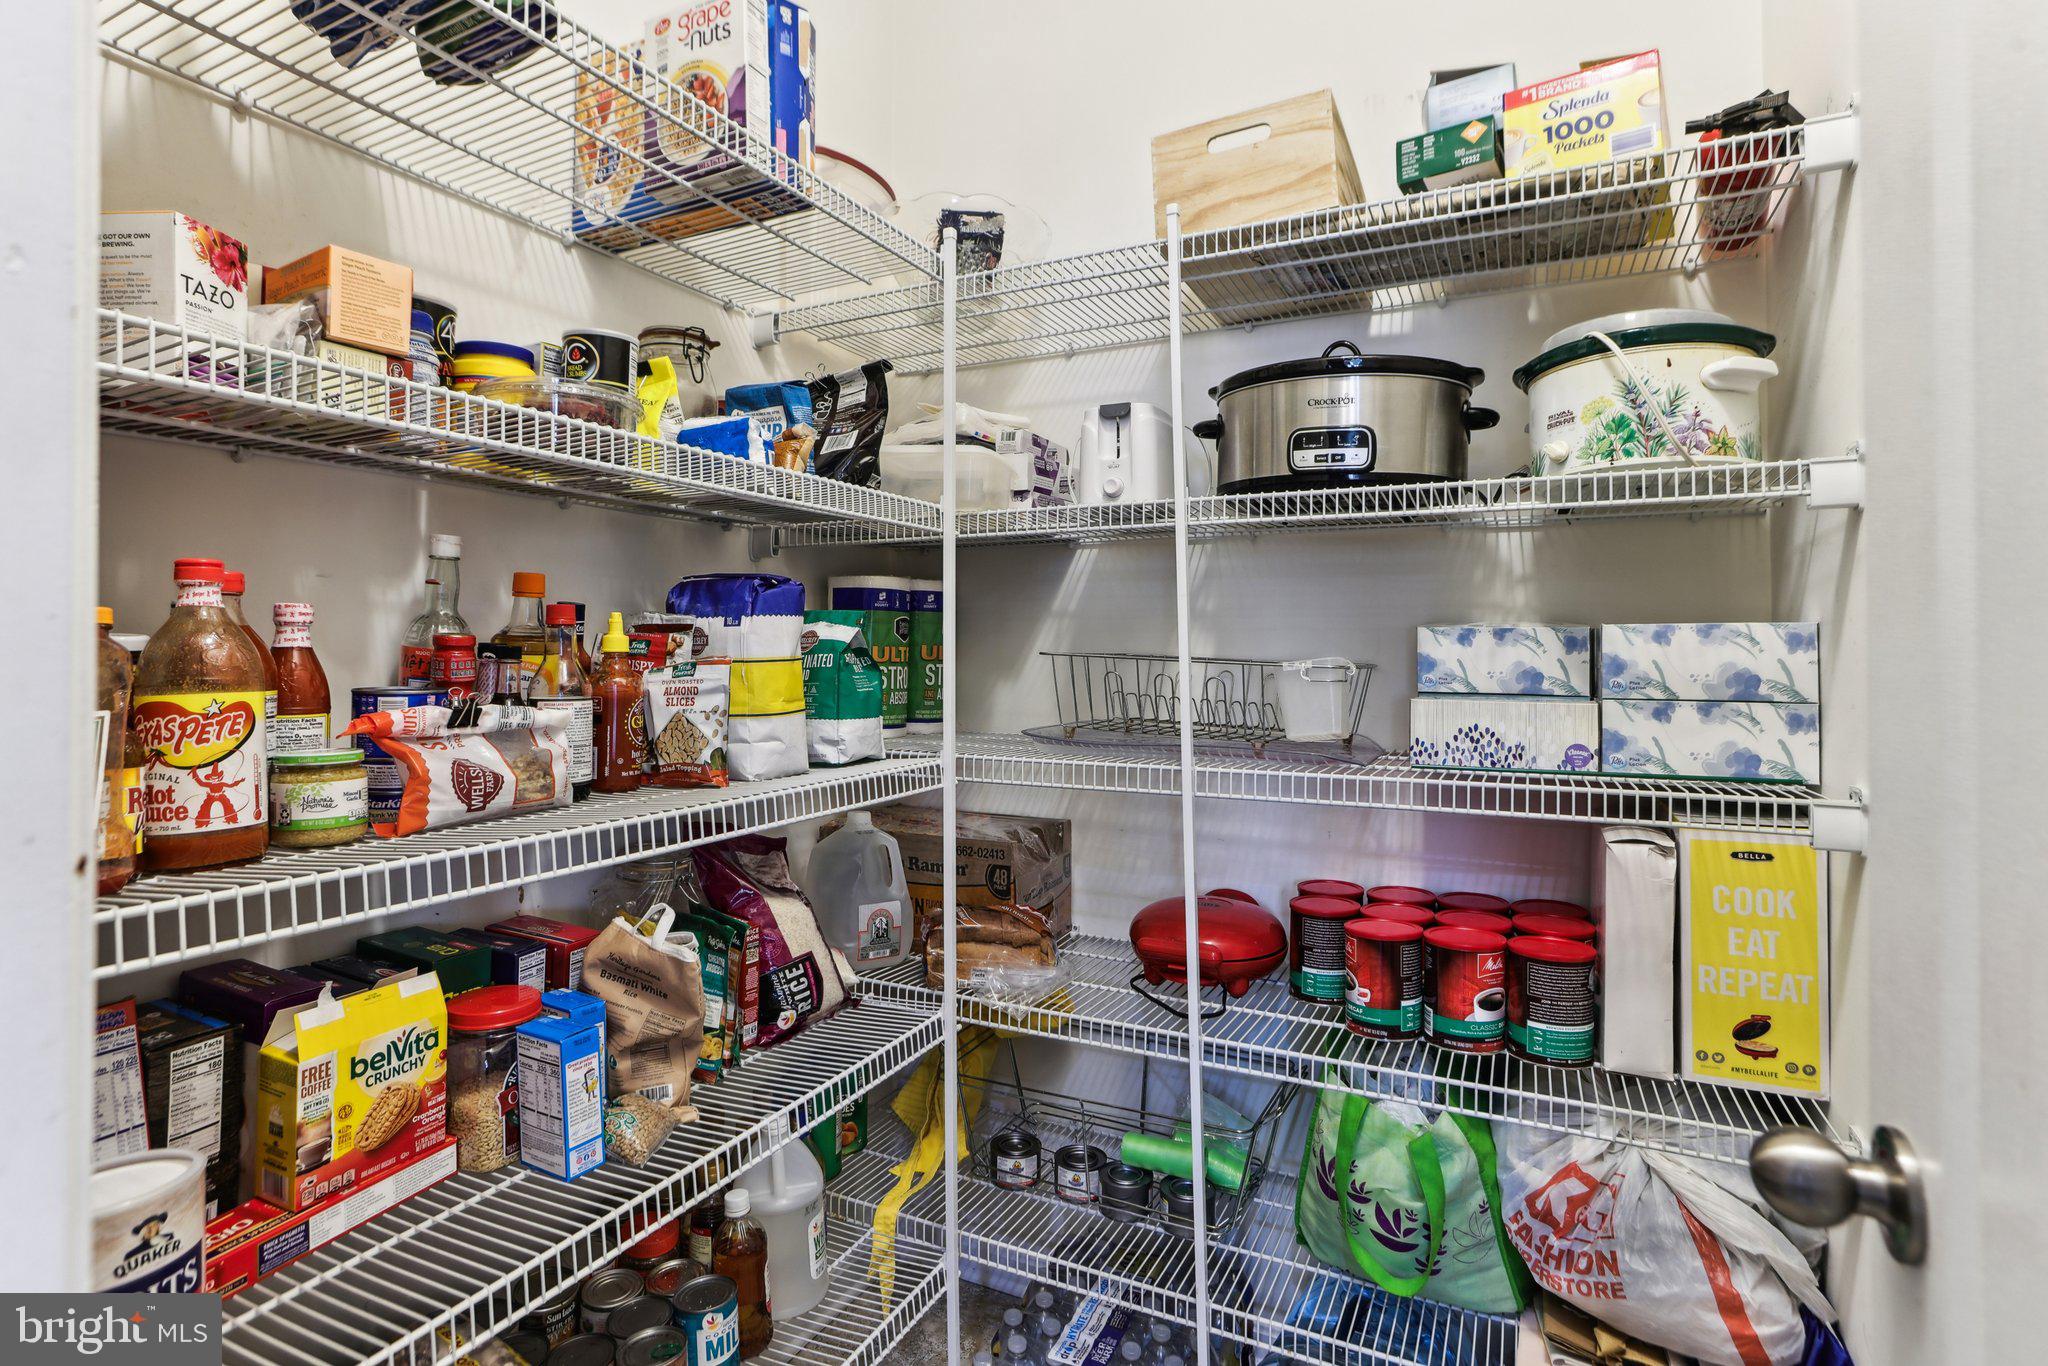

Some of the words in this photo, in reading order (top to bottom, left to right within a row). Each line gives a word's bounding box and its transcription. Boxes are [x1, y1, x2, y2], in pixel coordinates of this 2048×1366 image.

[678, 0, 731, 41] grape
[1521, 86, 1537, 102] #1
[1543, 90, 1610, 120] Splenda
[1543, 110, 1615, 143] 1000
[1554, 132, 1605, 155] Packets
[181, 273, 235, 310] TAZO
[185, 300, 213, 314] PASSION
[872, 645, 909, 663] ULT
[628, 660, 654, 672] ISPY
[663, 686, 699, 696] ALMOND
[665, 697, 696, 707] SLICES
[676, 764, 702, 774] Topping
[301, 794, 335, 804] Nature's
[367, 798, 402, 809] StarKi
[907, 855, 968, 877] Ramn
[1738, 852, 1767, 860] BELLA
[993, 869, 1008, 885] 48
[1712, 885, 1796, 919] COOK
[1728, 927, 1780, 959] EAT
[600, 969, 638, 989] Basmati
[640, 982, 669, 1000] White
[623, 989, 638, 998] Rice
[785, 962, 812, 1014] RICE
[1698, 964, 1813, 1005] REPEAT
[116, 1027, 135, 1037] Facts
[172, 1045, 202, 1060] Nutrition
[203, 1039, 222, 1050] Facts
[350, 1025, 439, 1080] belVita
[171, 1070, 197, 1082] Calories
[208, 1059, 222, 1070] 180
[301, 1060, 332, 1087] FREE
[366, 1055, 426, 1088] CRUNCHY
[1731, 1067, 1779, 1079] #MYBELLALIFE
[301, 1077, 332, 1098] COFFEE
[412, 1103, 446, 1123] Cranberry
[421, 1110, 446, 1125] Orange
[1509, 1210, 1620, 1277] FASHION
[113, 1239, 181, 1279] QUAKER
[546, 1312, 562, 1324] Sun
[705, 1328, 739, 1362] MIL
[1091, 1342, 1107, 1362] DEER
[1099, 1344, 1115, 1365] PARK
